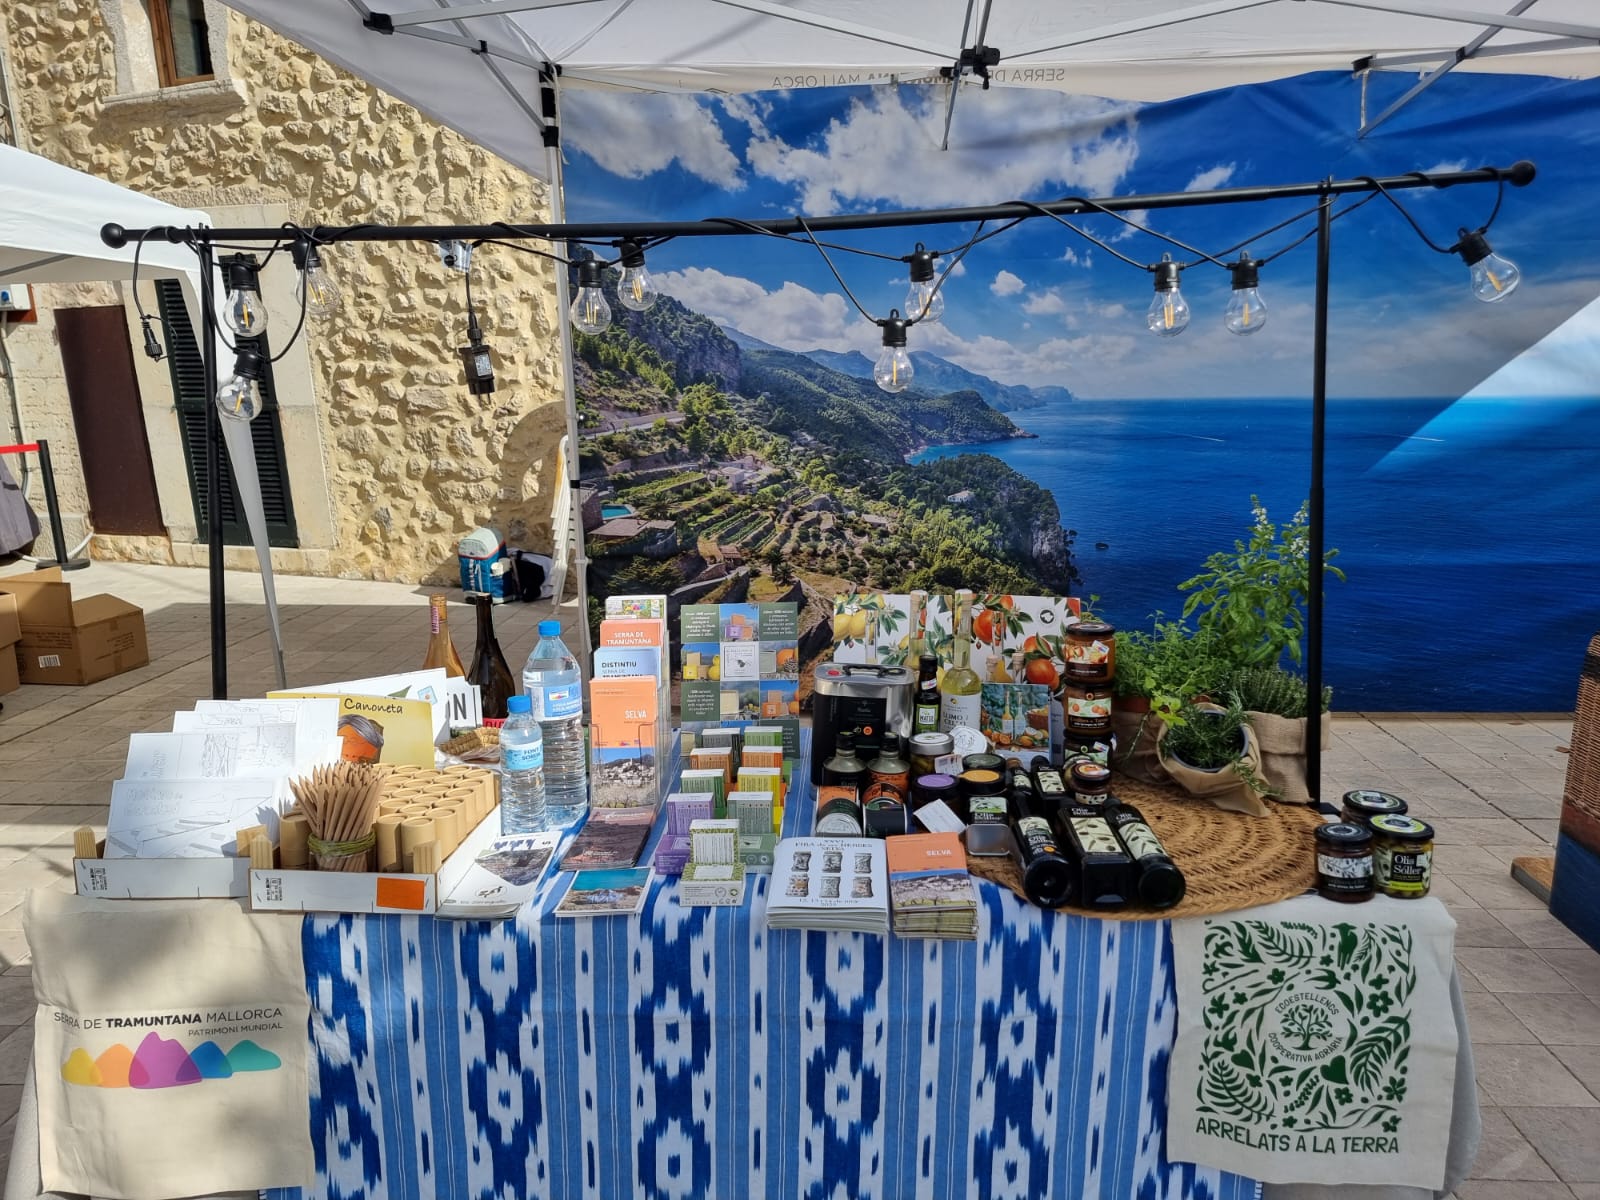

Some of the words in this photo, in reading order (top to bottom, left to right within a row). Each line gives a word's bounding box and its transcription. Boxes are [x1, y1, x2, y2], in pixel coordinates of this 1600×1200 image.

[344, 698, 403, 714] Canoneta
[624, 710, 647, 719] SELVA
[54, 1011, 80, 1029] SERRA
[84, 1019, 102, 1029] DE
[105, 1012, 201, 1029] TRAMUNTANA
[206, 1007, 283, 1023] MALLORCA
[188, 1026, 238, 1037] PATRIMONI
[241, 1022, 283, 1034] MUNDIAL
[1268, 1032, 1313, 1062] COOPERATIVA
[1195, 1117, 1290, 1151] ARRELATS
[1295, 1136, 1307, 1152] A
[1313, 1135, 1336, 1154] LA
[1342, 1136, 1400, 1154] TERRA
